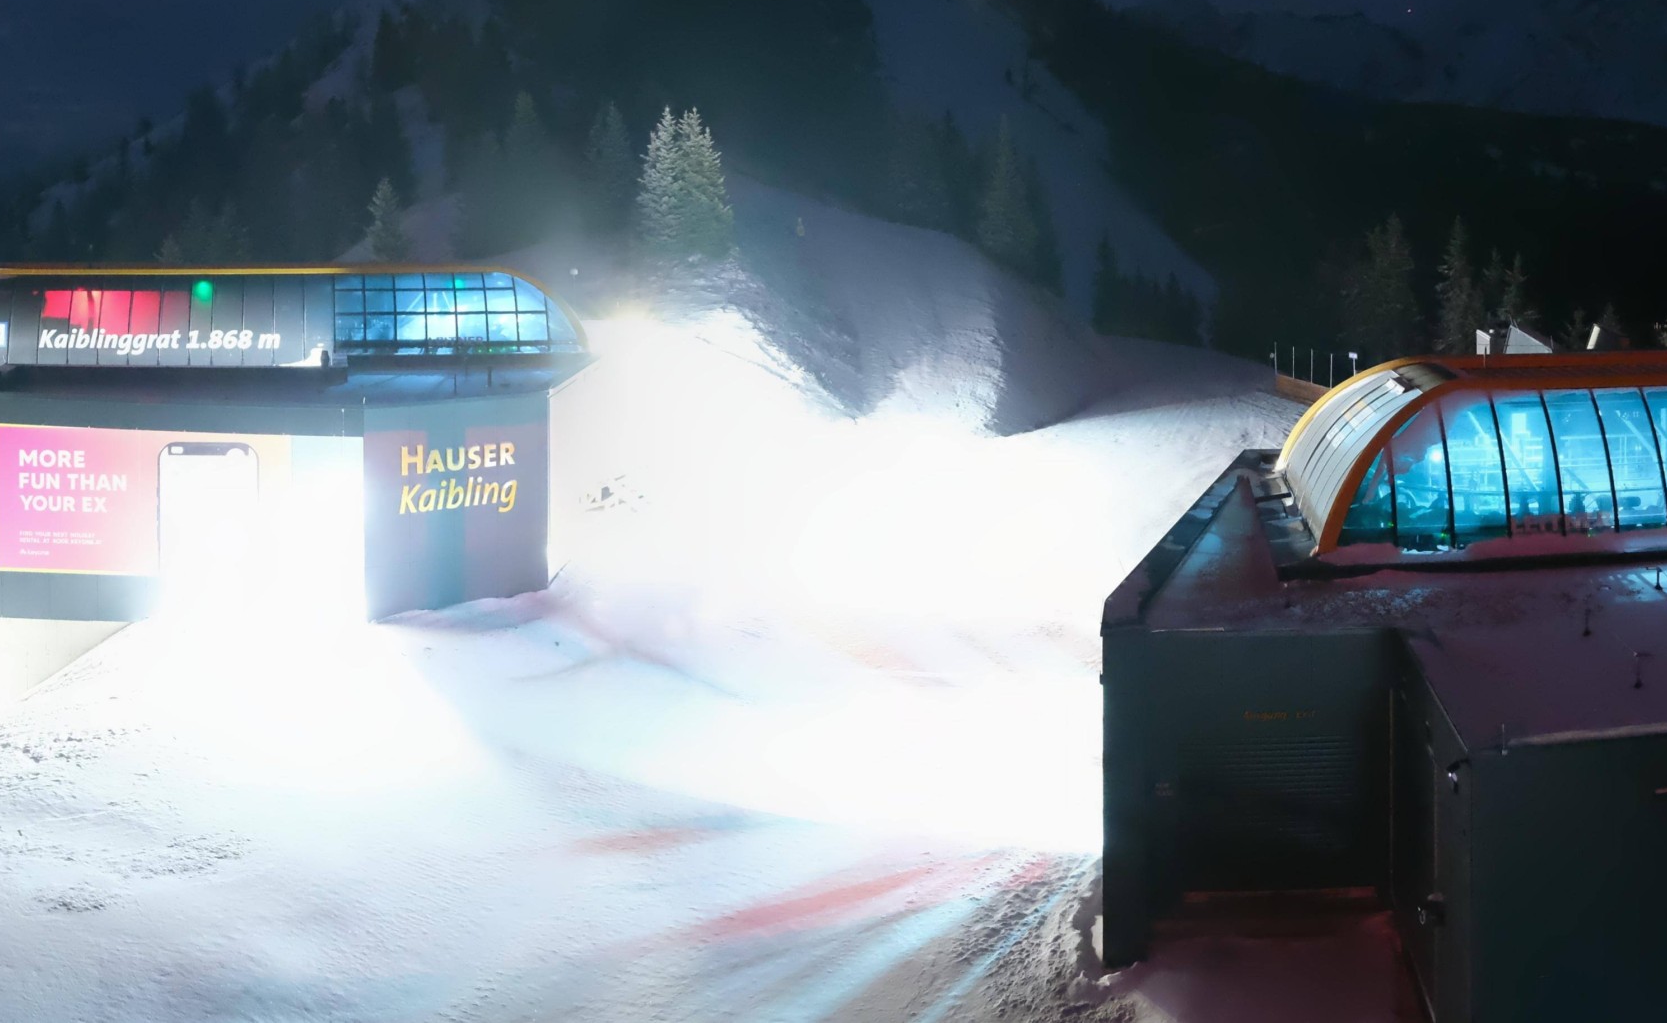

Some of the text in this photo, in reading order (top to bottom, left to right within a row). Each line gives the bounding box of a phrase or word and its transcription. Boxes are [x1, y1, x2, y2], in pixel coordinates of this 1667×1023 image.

[39, 329, 280, 355] Kaiblinggrat 1.868 m
[19, 449, 85, 468] MORE
[401, 442, 516, 476] HAUSER
[19, 472, 127, 491] FUN THAN
[20, 495, 107, 513] YOUR EX
[399, 476, 518, 515] Kaibling
